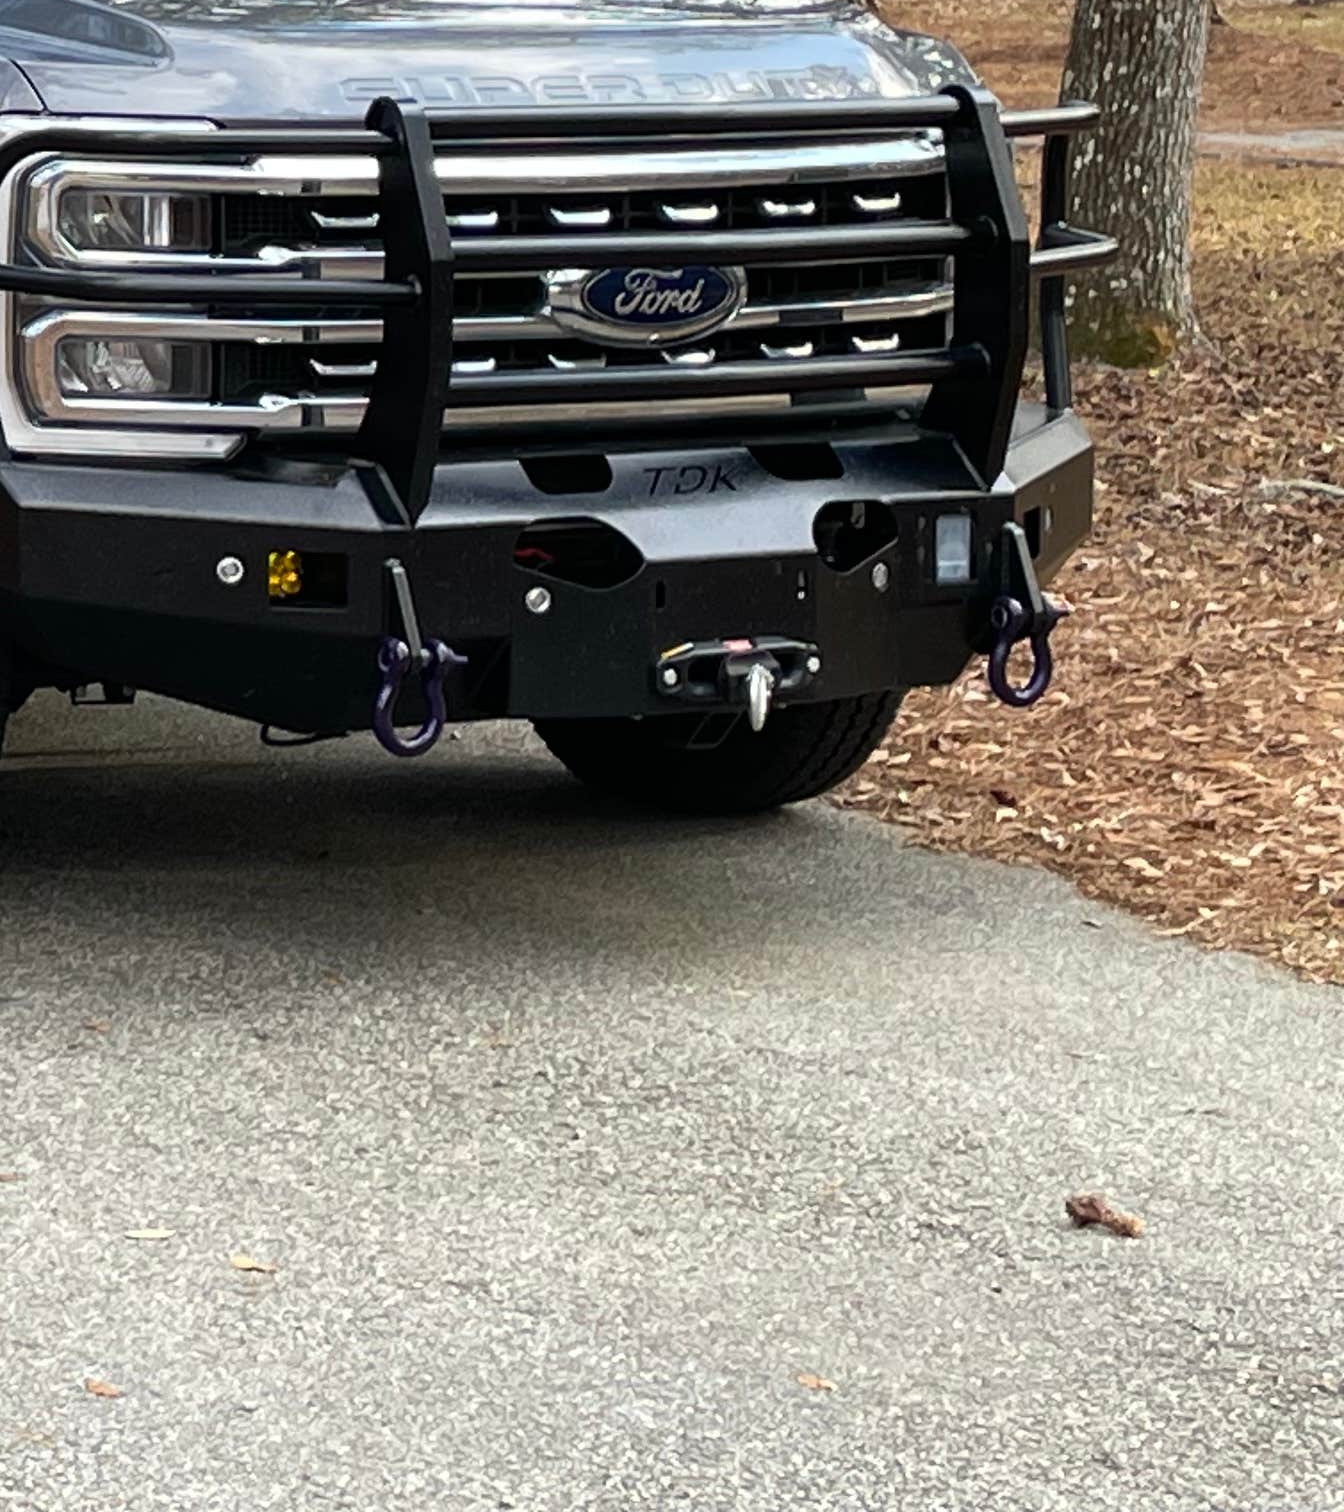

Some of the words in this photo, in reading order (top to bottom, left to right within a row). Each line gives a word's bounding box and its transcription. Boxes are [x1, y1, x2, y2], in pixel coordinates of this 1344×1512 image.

[338, 74, 649, 105] SUPER
[614, 268, 705, 316] Ford
[642, 465, 737, 497] TDK
